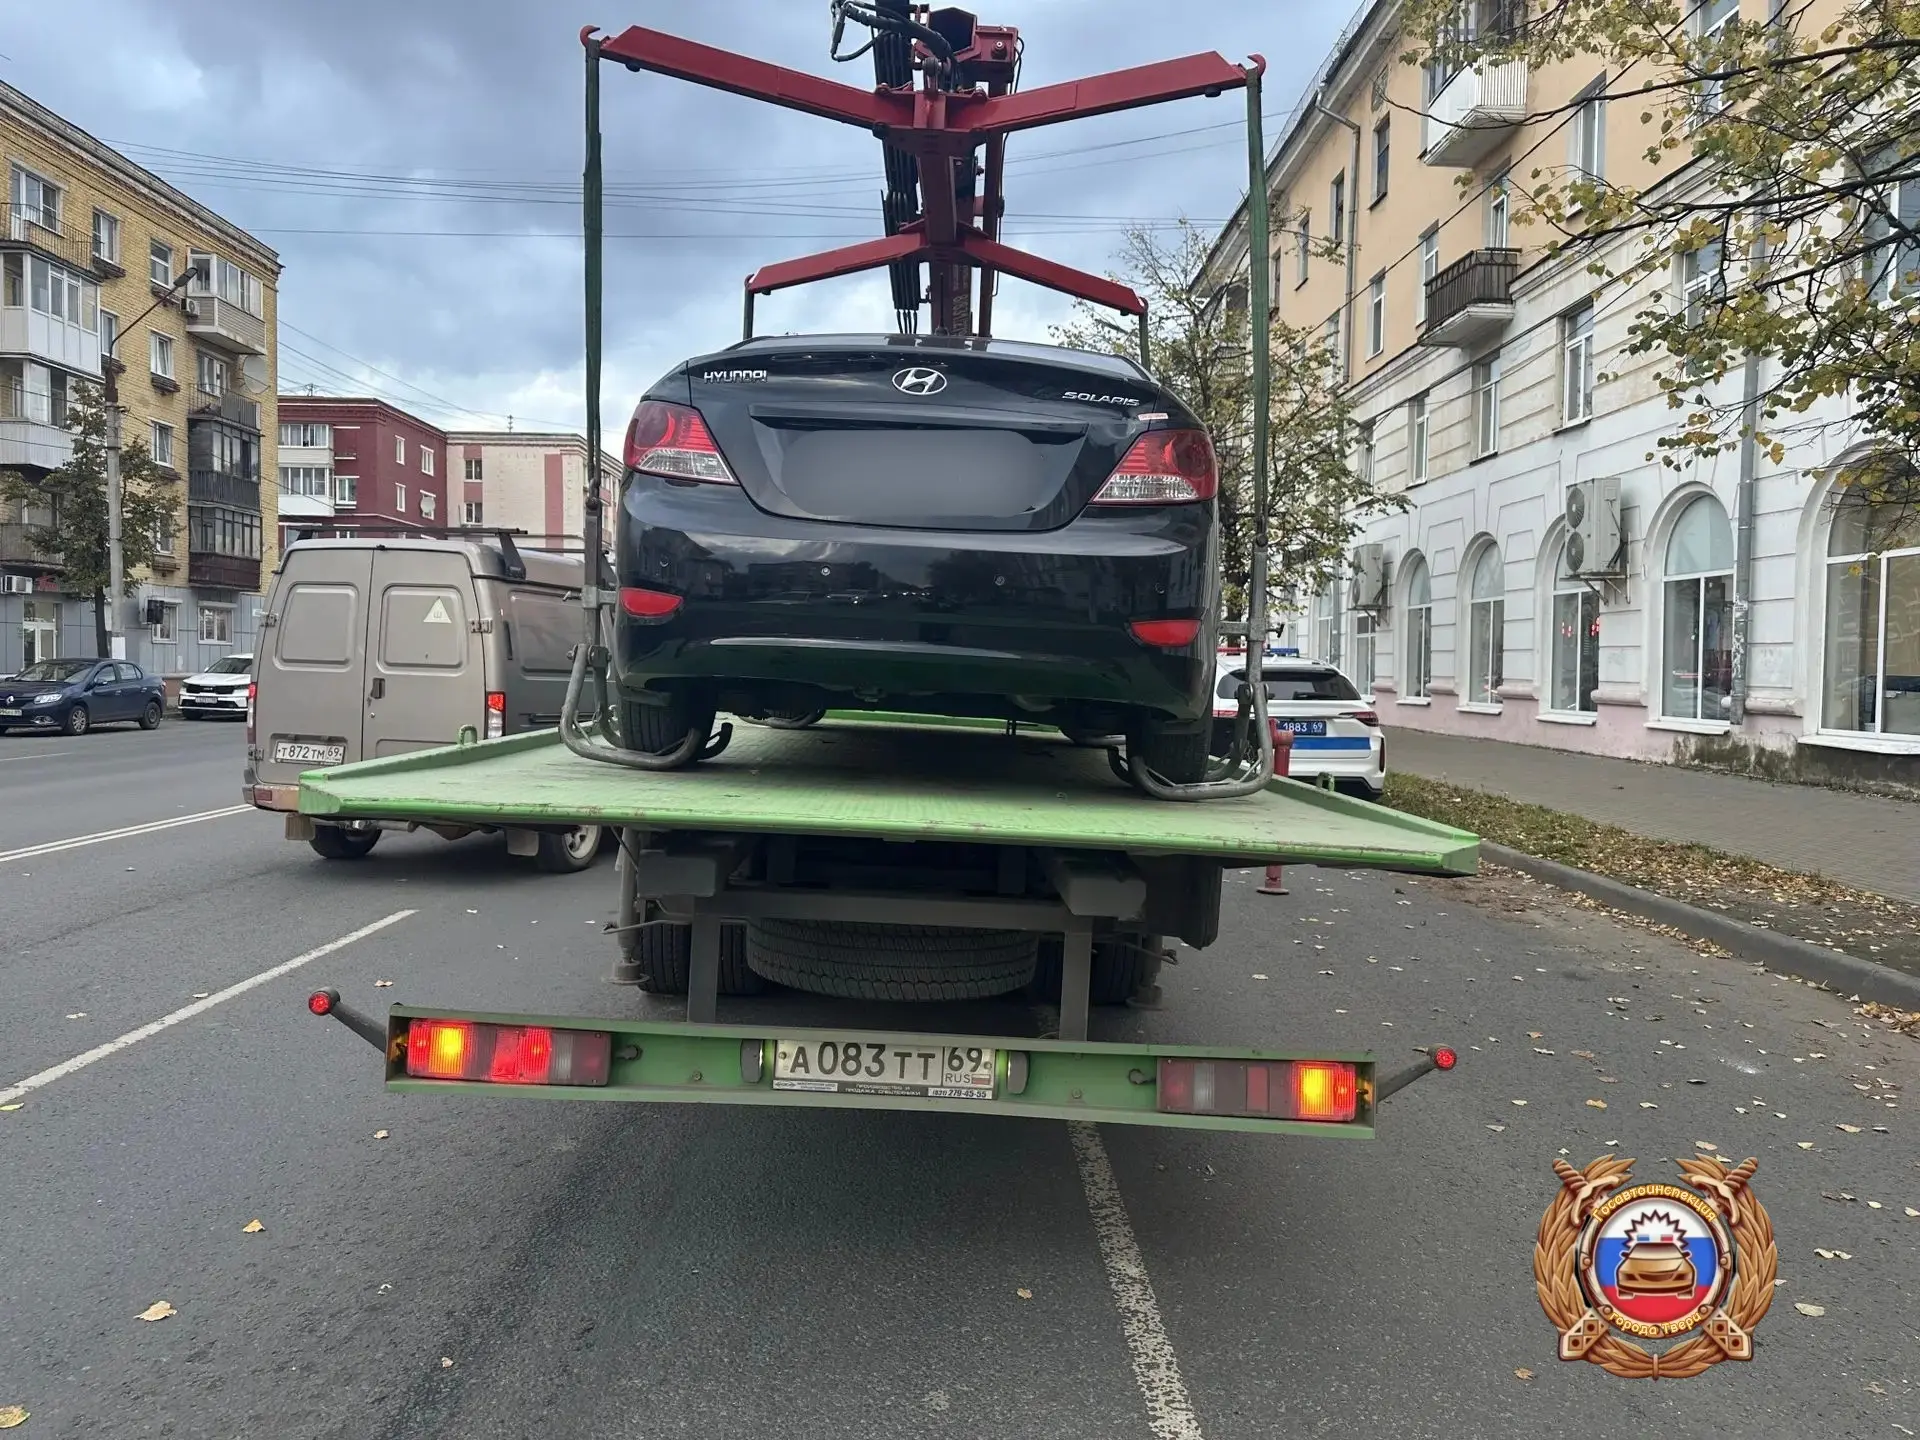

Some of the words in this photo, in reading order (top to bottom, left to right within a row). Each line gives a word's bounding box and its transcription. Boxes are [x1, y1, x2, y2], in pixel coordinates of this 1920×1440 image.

[704, 369, 767, 384] HYUNDAI
[1062, 391, 1140, 407] SOLARIS
[947, 1047, 984, 1073] 69
[944, 1073, 971, 1084] RUS
